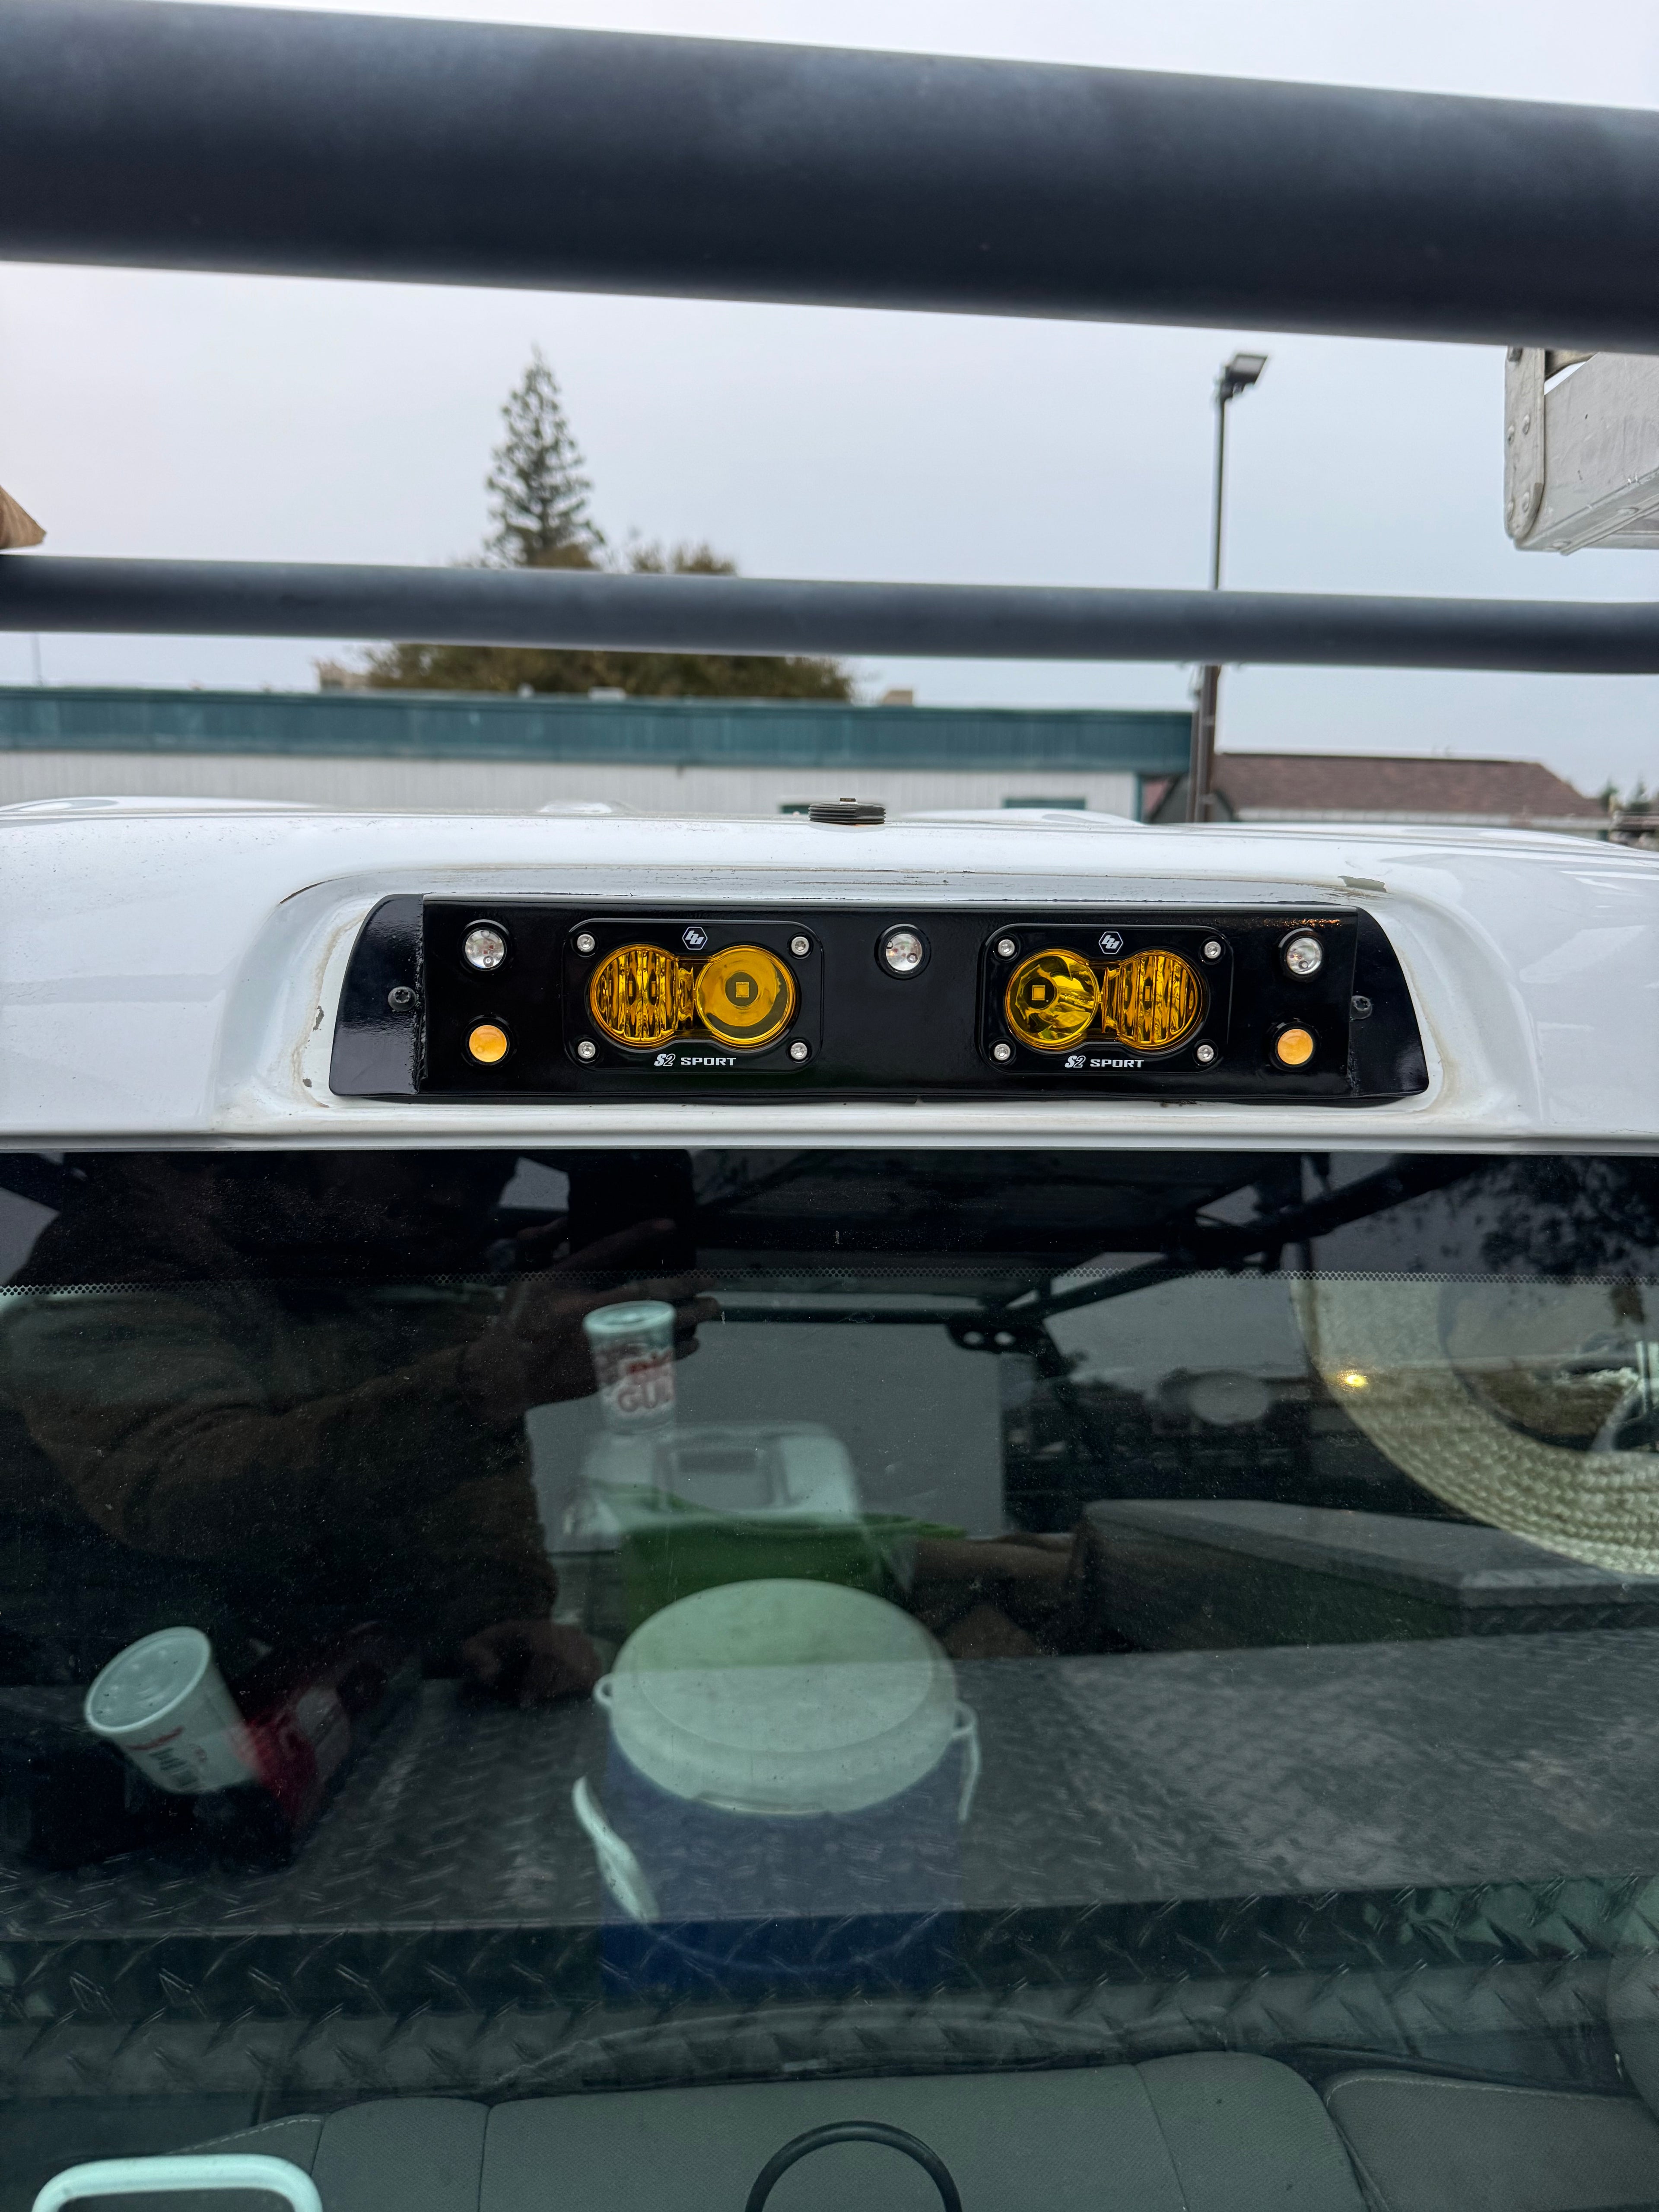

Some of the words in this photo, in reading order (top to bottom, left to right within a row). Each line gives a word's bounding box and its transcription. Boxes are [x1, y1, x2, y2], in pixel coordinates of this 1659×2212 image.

[654, 1053, 676, 1066] S2
[680, 1057, 737, 1066] SPORT
[1064, 1055, 1086, 1068] S2
[1090, 1058, 1144, 1068] SPORT
